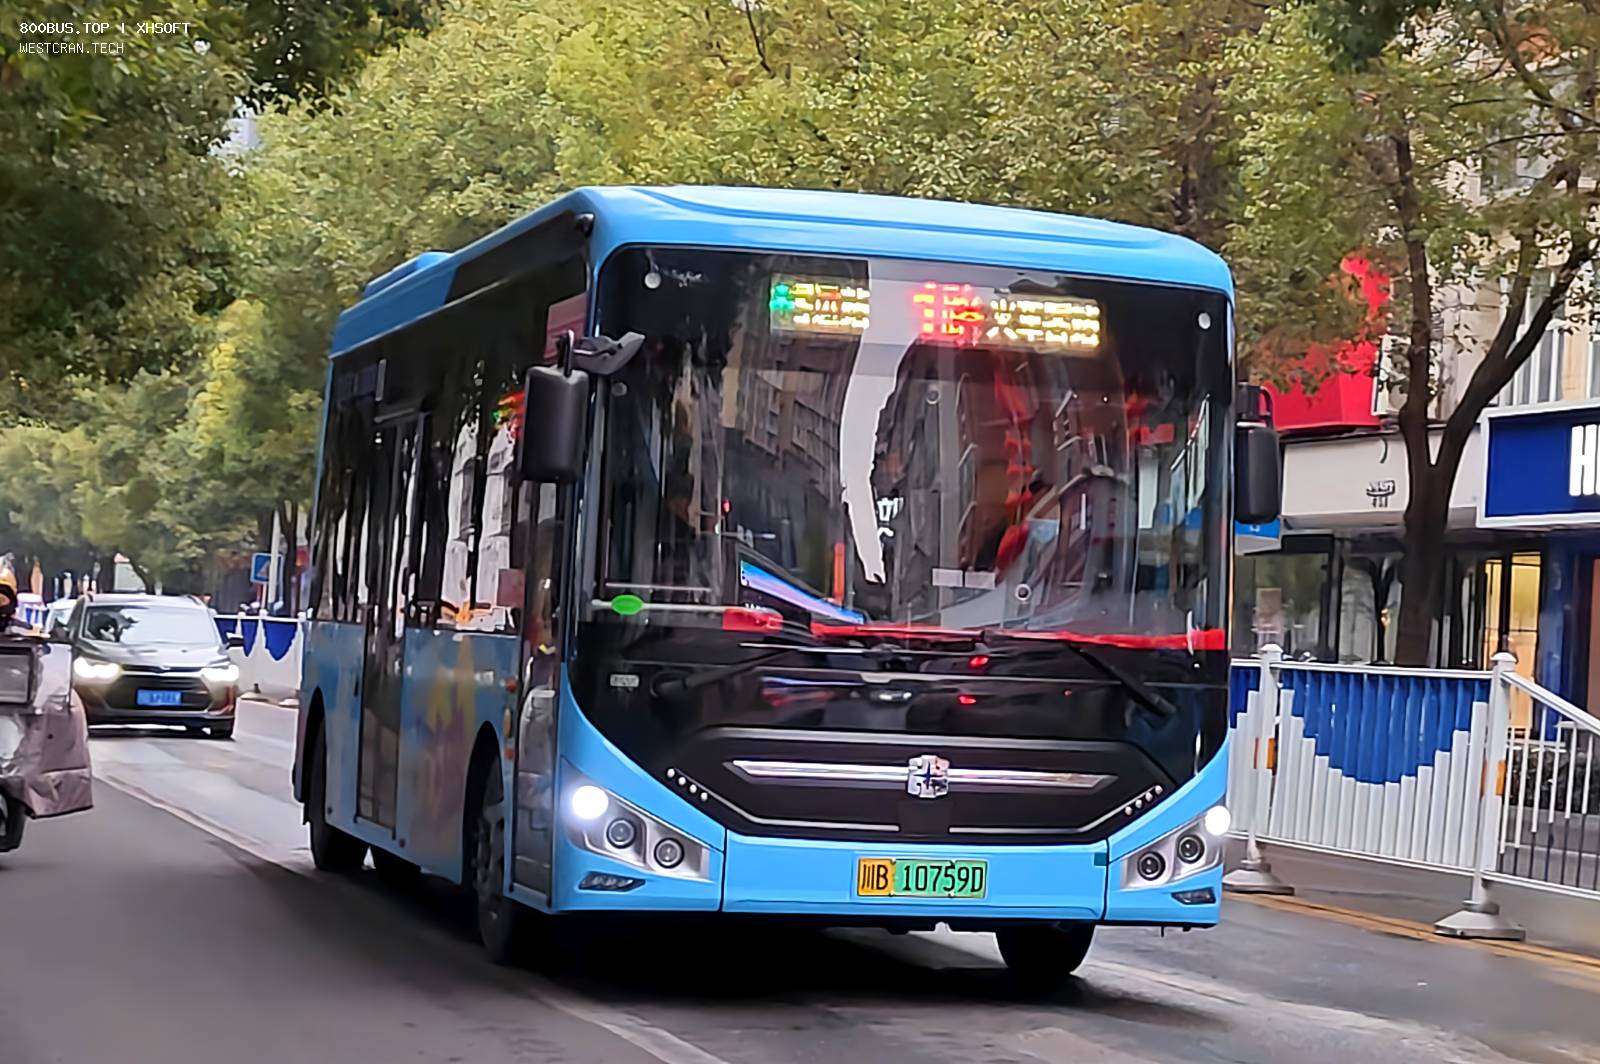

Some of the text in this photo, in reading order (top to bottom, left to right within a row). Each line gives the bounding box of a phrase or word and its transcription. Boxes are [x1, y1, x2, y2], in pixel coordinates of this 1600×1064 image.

[1569, 424, 1600, 497] H
[861, 864, 984, 893] 川B 10759D
